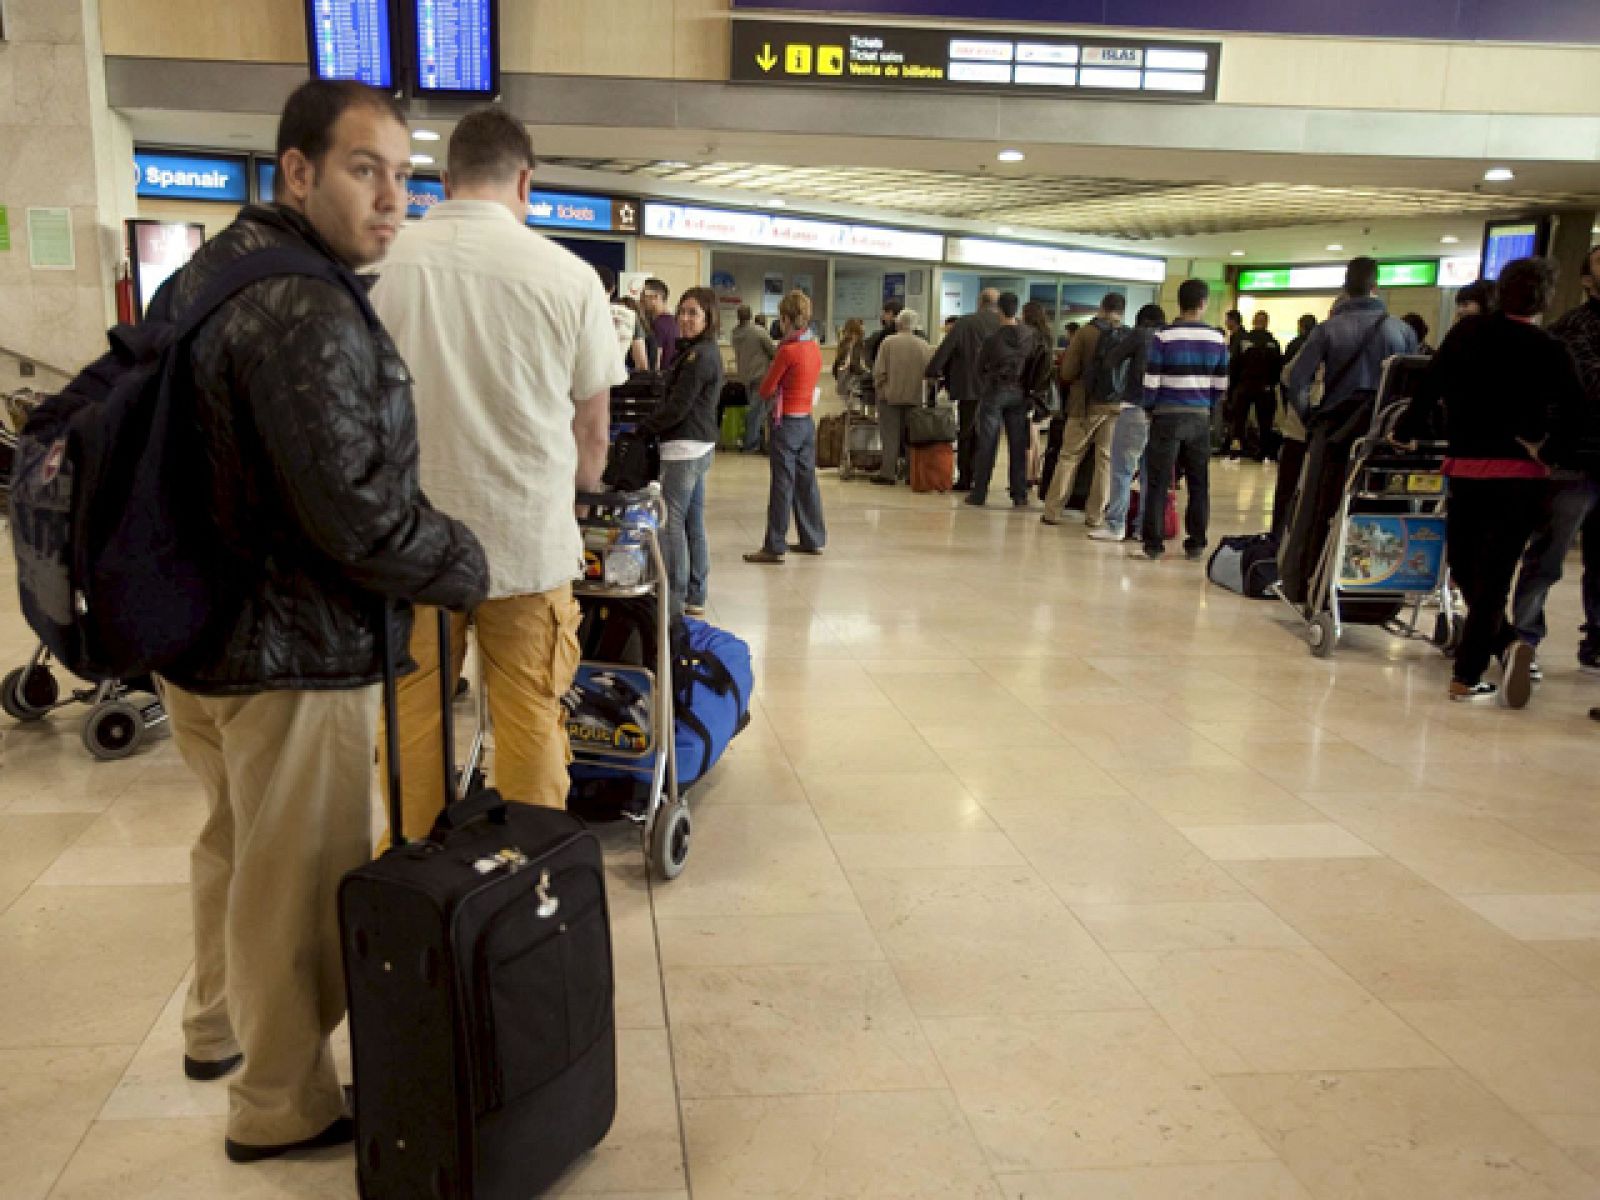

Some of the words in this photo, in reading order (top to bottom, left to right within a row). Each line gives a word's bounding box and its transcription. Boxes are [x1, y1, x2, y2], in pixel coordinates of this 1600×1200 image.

[849, 61, 881, 76] Venta
[884, 64, 900, 77] de
[901, 64, 944, 79] billetes
[146, 164, 230, 189] Spanair
